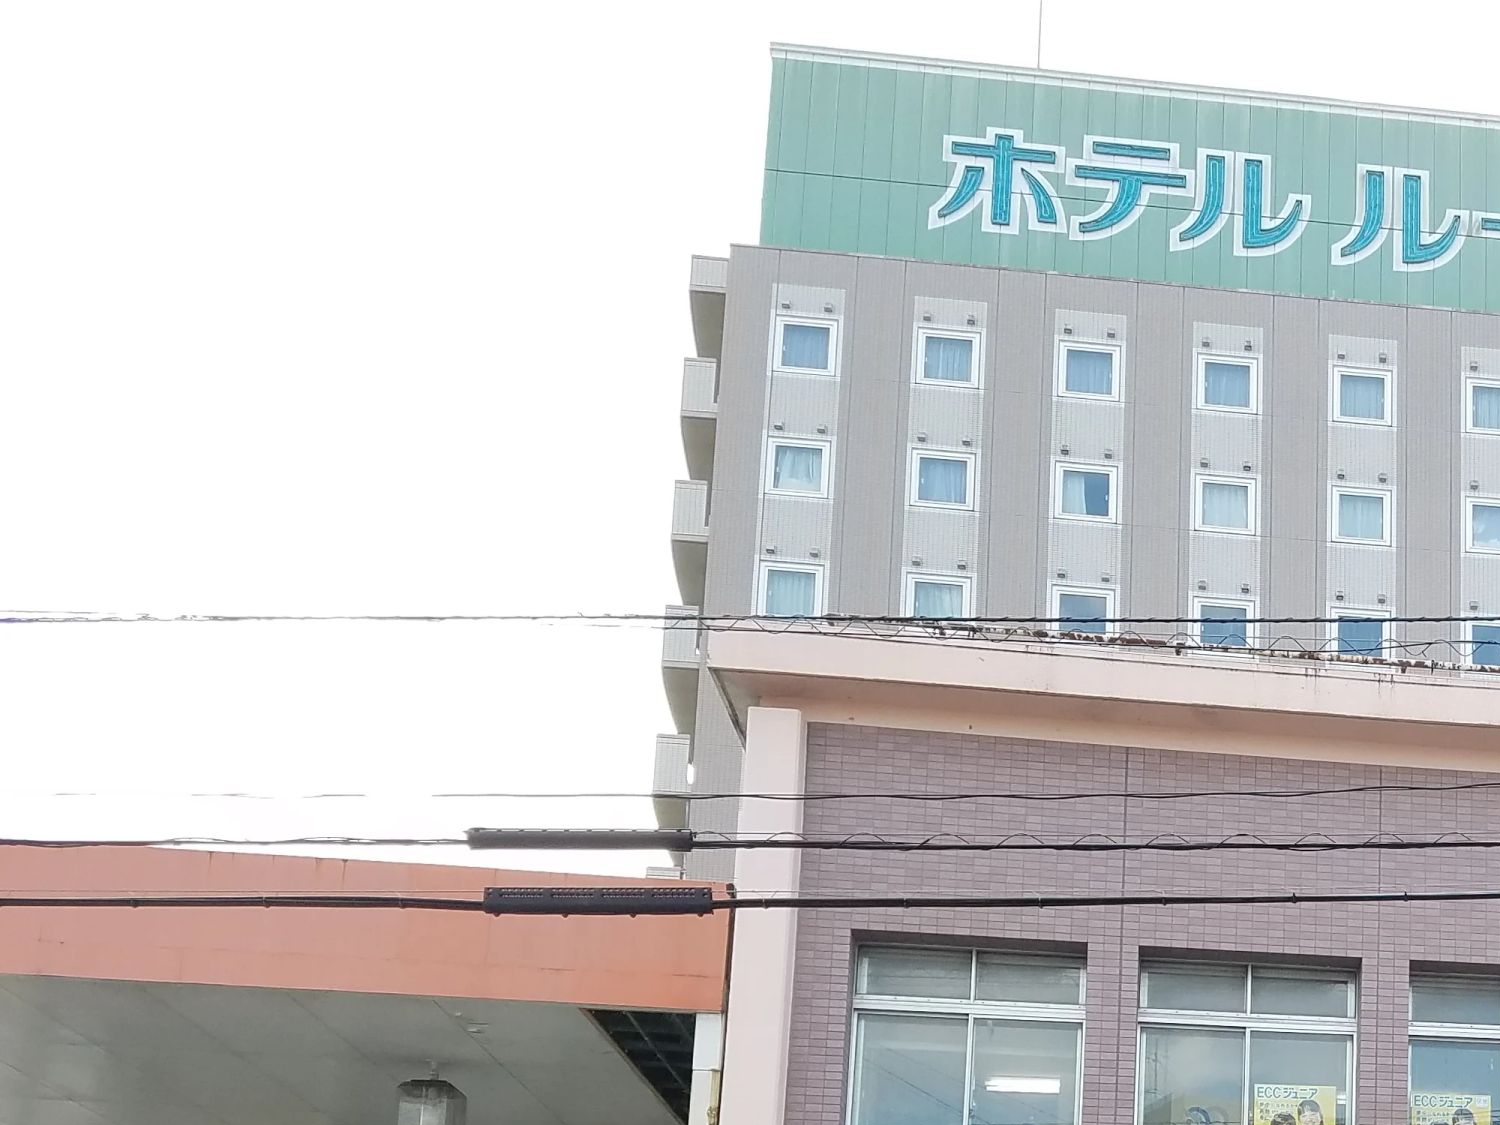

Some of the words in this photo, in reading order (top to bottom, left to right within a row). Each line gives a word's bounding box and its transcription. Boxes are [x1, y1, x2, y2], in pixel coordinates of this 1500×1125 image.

[930, 127, 1311, 255] ホテル
[1257, 1086, 1318, 1100] ECCジュニア
[1414, 1094, 1473, 1108] ECCジュニア
